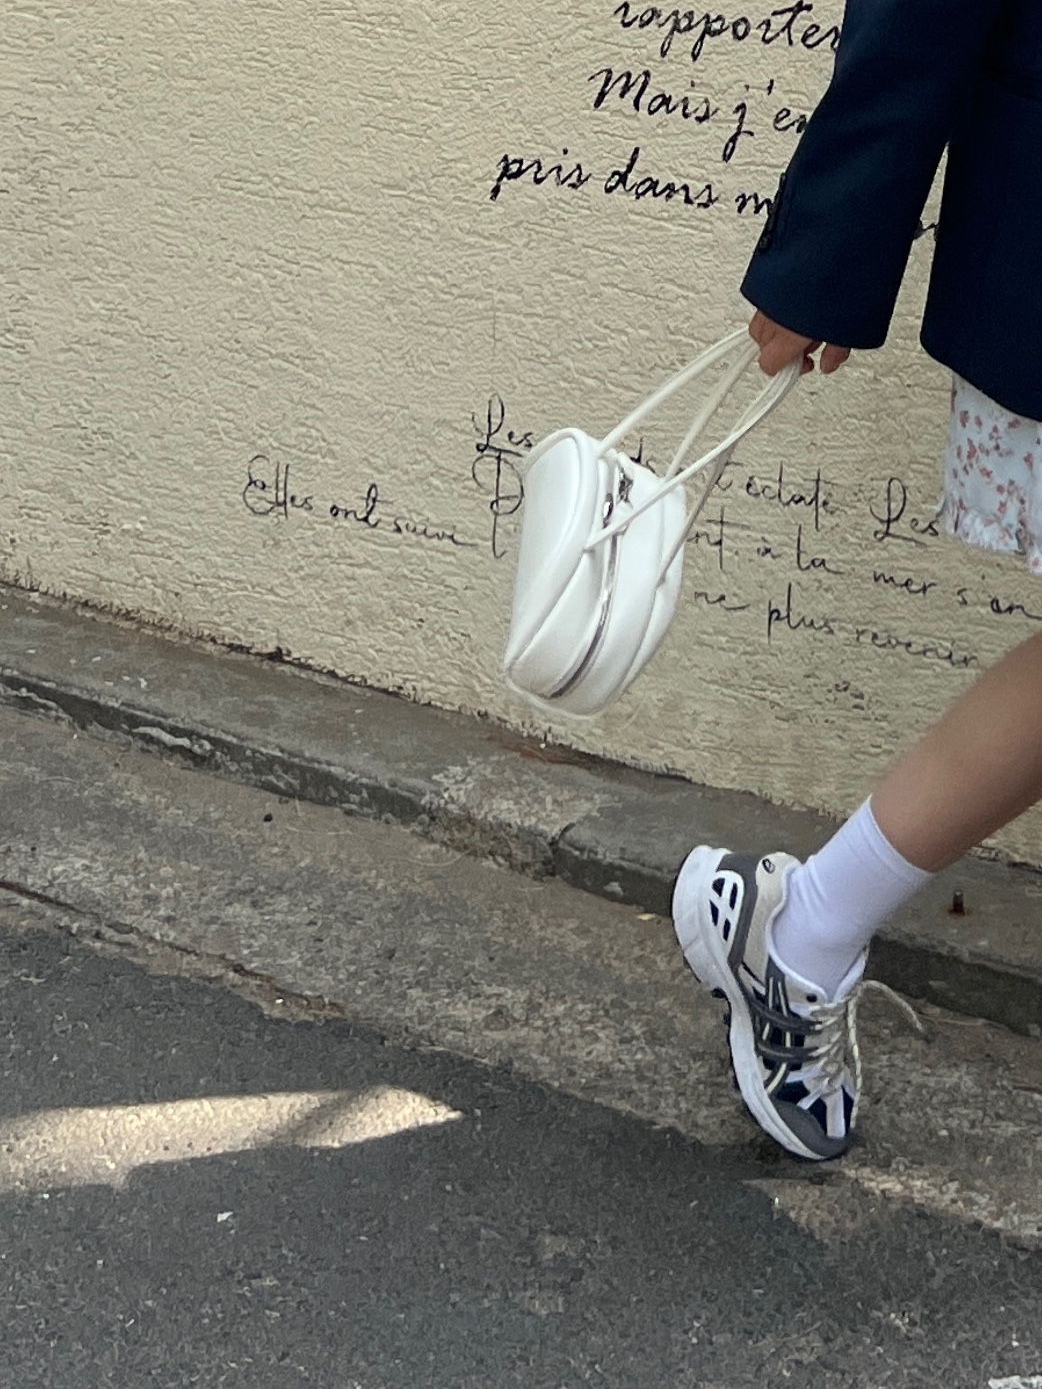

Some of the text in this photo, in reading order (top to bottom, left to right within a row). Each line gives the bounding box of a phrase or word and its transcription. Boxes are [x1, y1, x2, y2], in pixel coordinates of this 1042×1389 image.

[588, 67, 719, 122] Mais
[490, 148, 591, 201] pris
[604, 147, 719, 209] dans
[767, 583, 837, 646] plus
